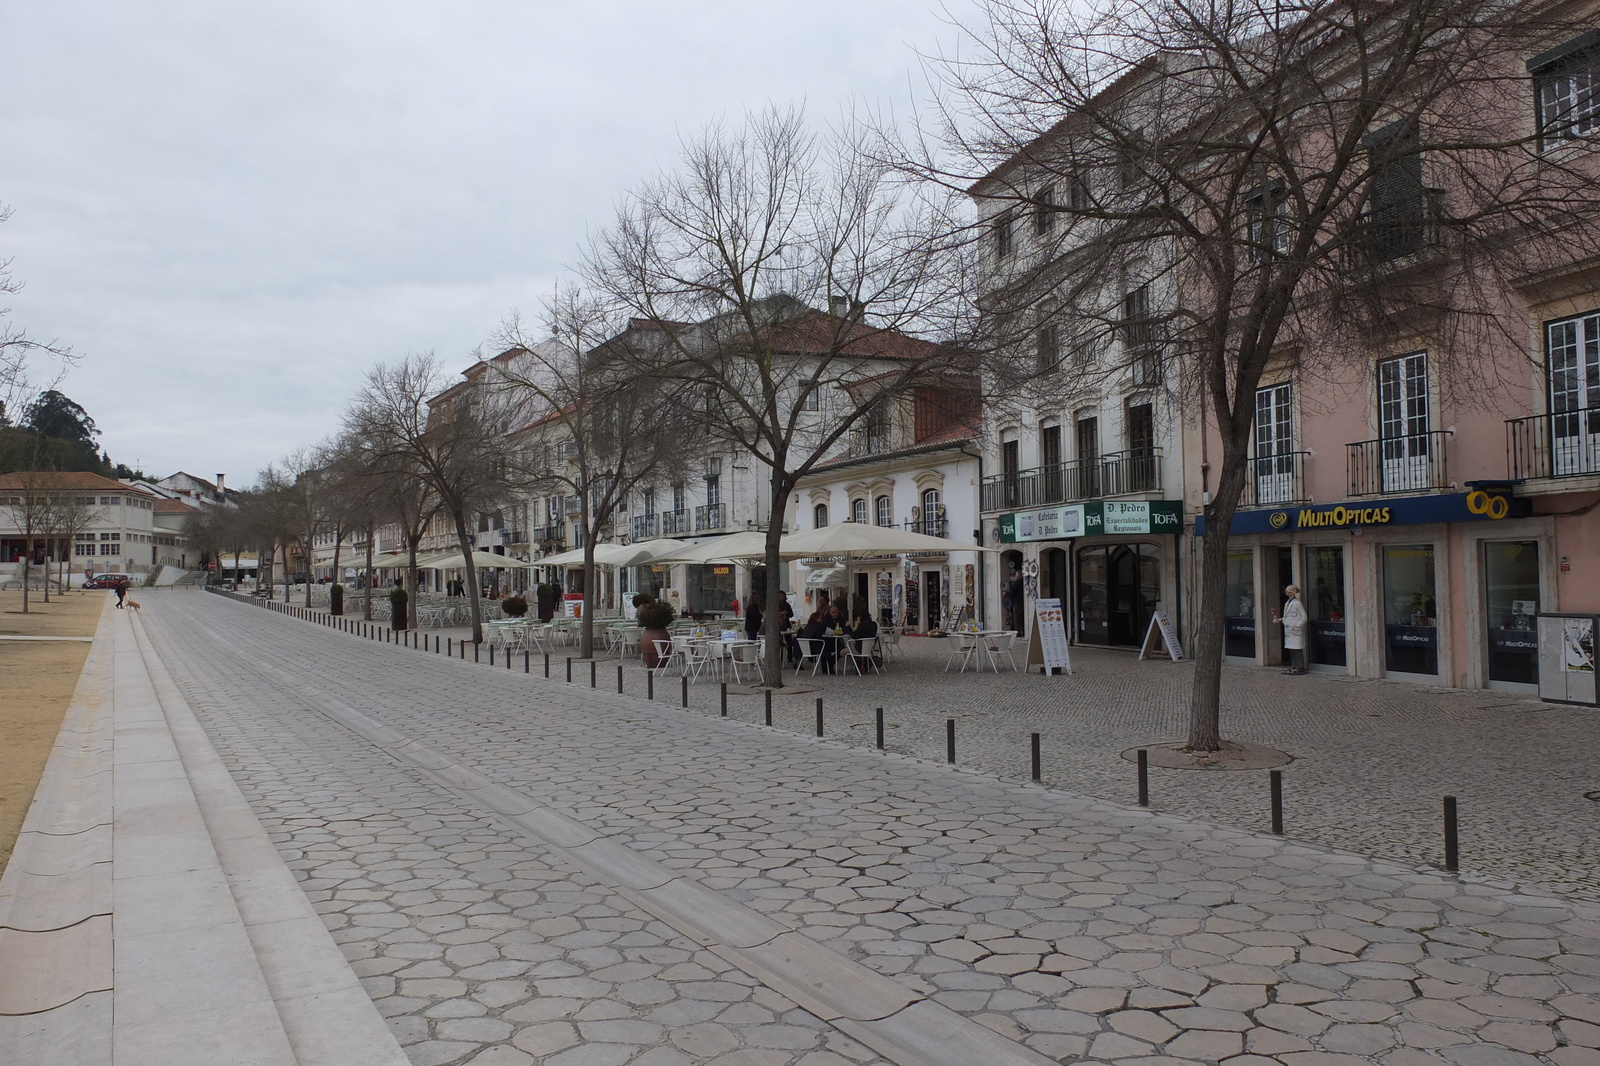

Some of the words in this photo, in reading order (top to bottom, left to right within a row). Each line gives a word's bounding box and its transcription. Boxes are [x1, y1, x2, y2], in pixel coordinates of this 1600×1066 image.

[1107, 503, 1117, 513] D.
[1120, 503, 1146, 514] Pedro
[1086, 514, 1102, 527] TOFA
[1106, 517, 1149, 525] Especialidades
[1152, 513, 1178, 525] TOFA
[1002, 524, 1015, 535] TOFA
[1044, 525, 1059, 537] Pedro
